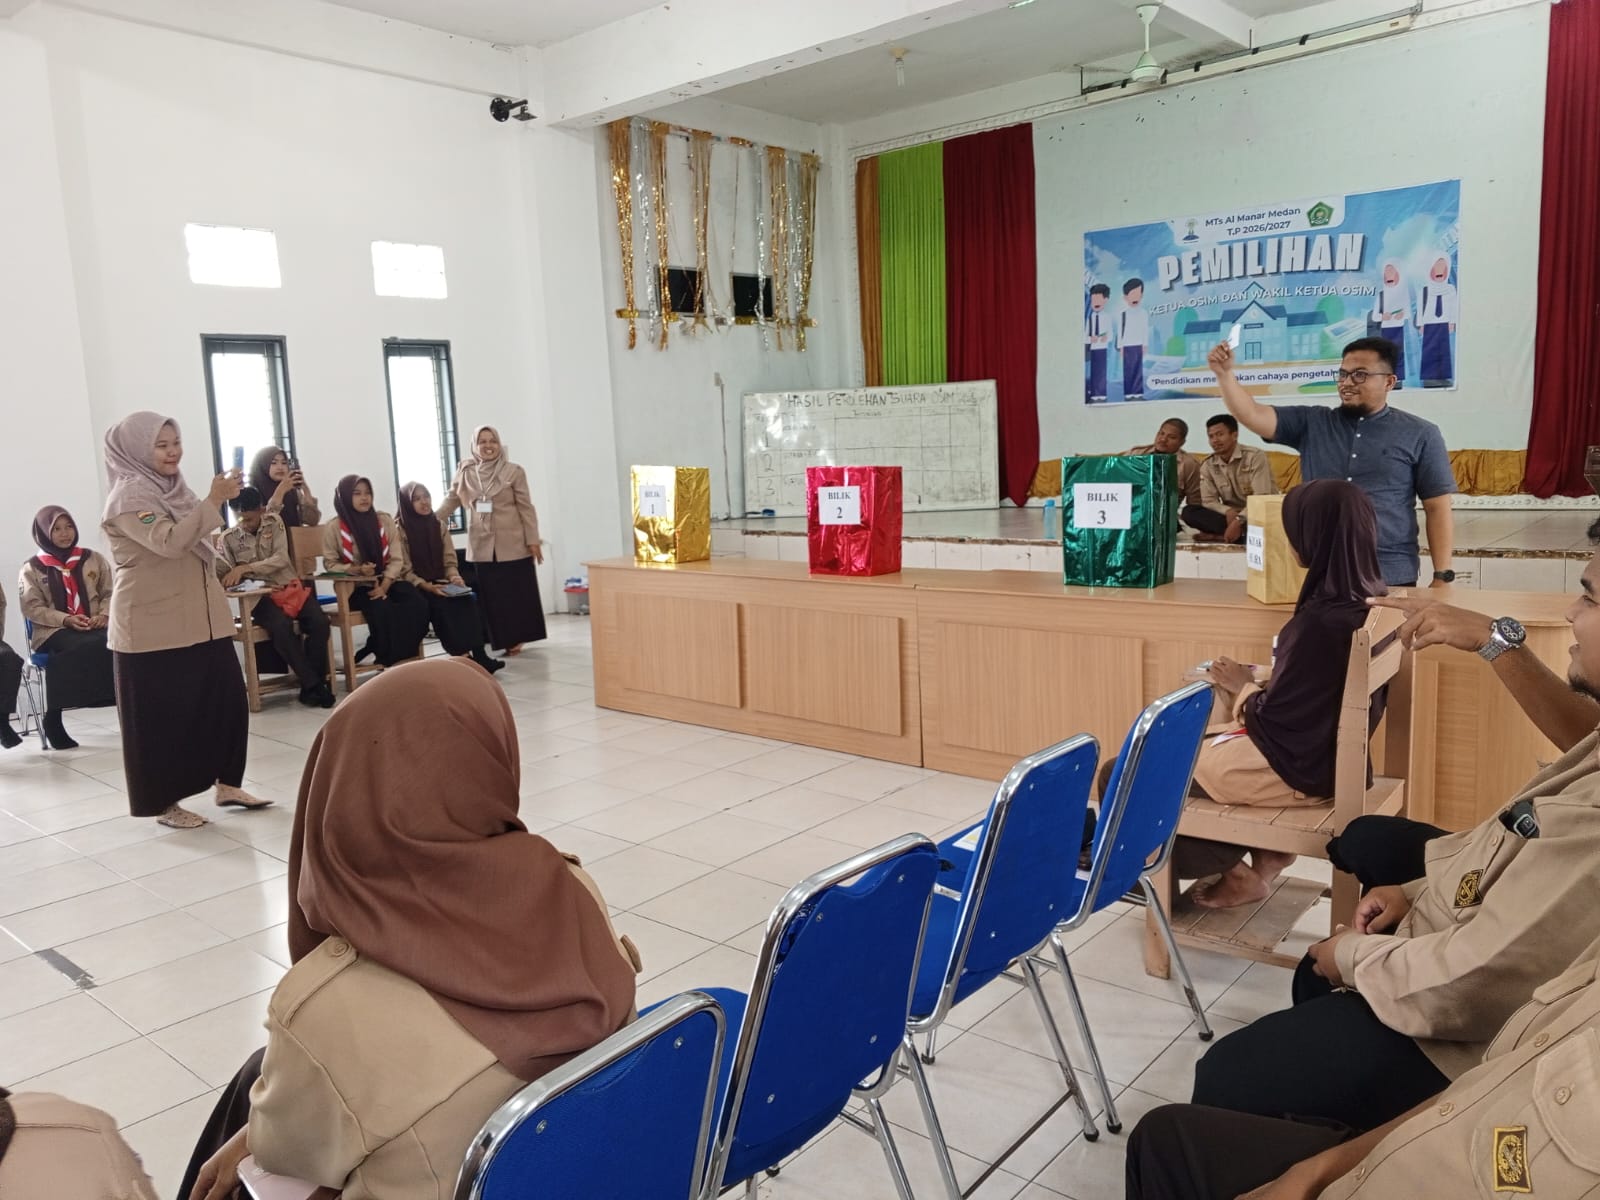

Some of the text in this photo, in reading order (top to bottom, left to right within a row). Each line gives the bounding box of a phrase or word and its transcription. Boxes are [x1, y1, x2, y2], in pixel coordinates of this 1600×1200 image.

[1205, 207, 1301, 227] MTs Al Manar Medan
[1227, 220, 1291, 236] T.P 2026/2027
[1157, 233, 1365, 291] PEMILIHAN
[1150, 285, 1376, 316] KETUA OSIM DAN WAKIL KETUA OSIM
[1257, 370, 1289, 381] cahaya
[787, 393, 824, 408] HASIL
[890, 392, 926, 405] SUARA
[828, 491, 851, 500] BILIK
[1087, 492, 1119, 502] BILIK
[837, 506, 843, 519] 2
[1097, 510, 1106, 525] 3
